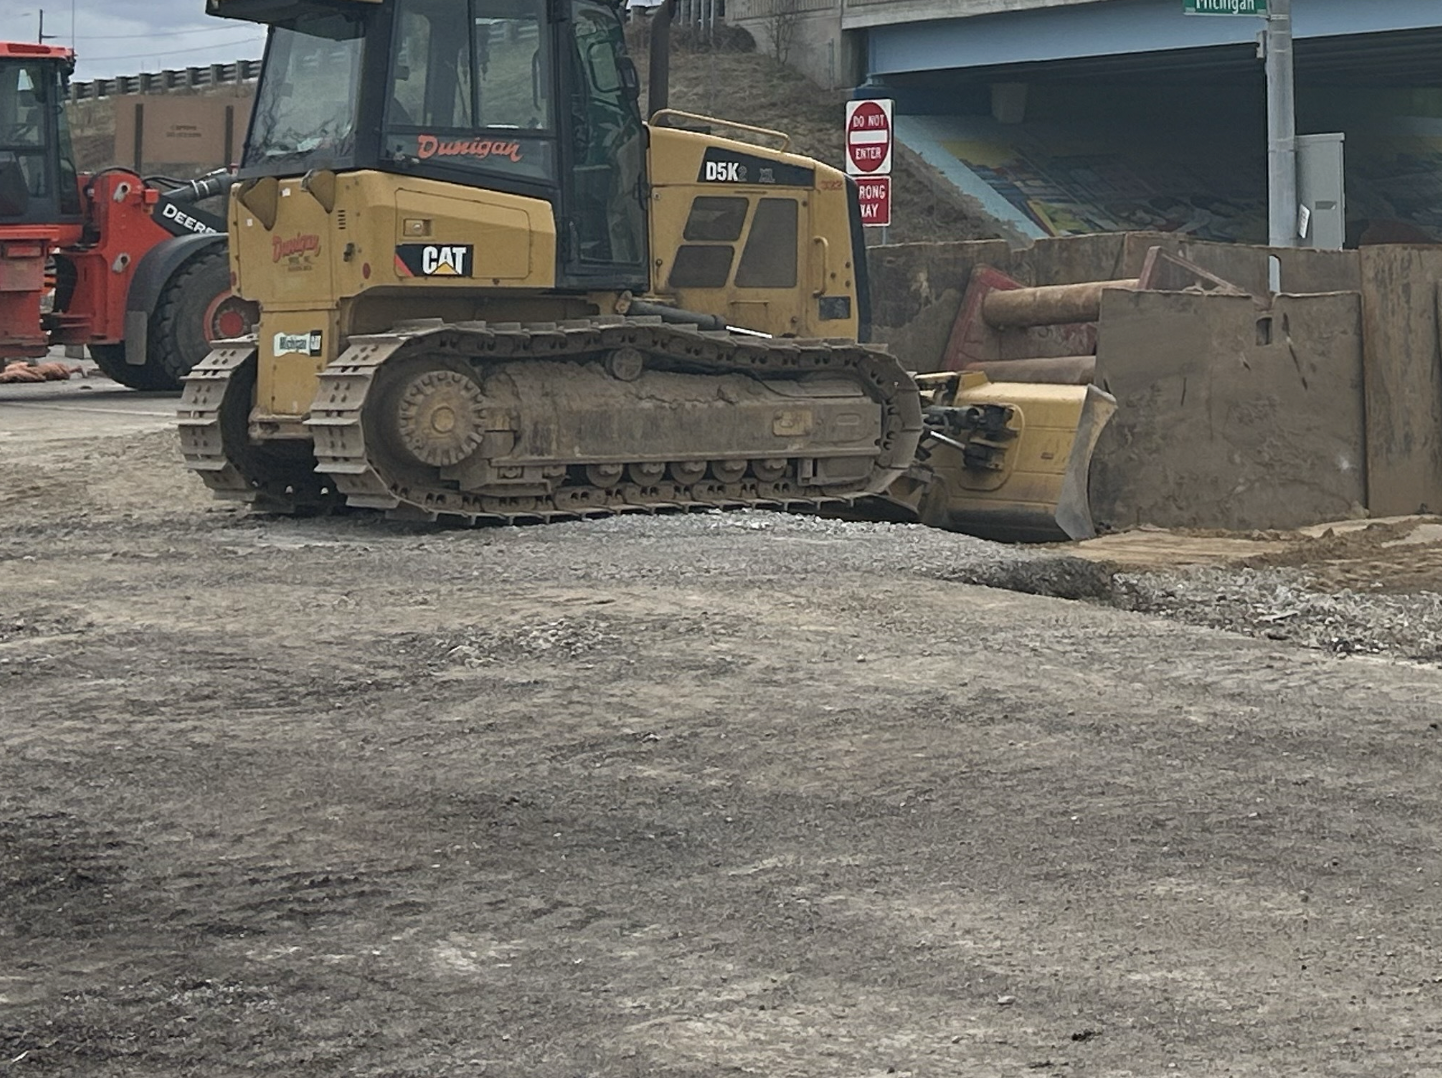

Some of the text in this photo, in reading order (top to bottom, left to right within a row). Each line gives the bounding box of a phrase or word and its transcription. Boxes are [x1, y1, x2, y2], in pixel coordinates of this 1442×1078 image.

[853, 114, 885, 128] DO NOT
[417, 134, 524, 162] Dunigan
[855, 147, 882, 160] ENTER
[859, 185, 886, 199] RONG
[422, 246, 466, 275] CAT
